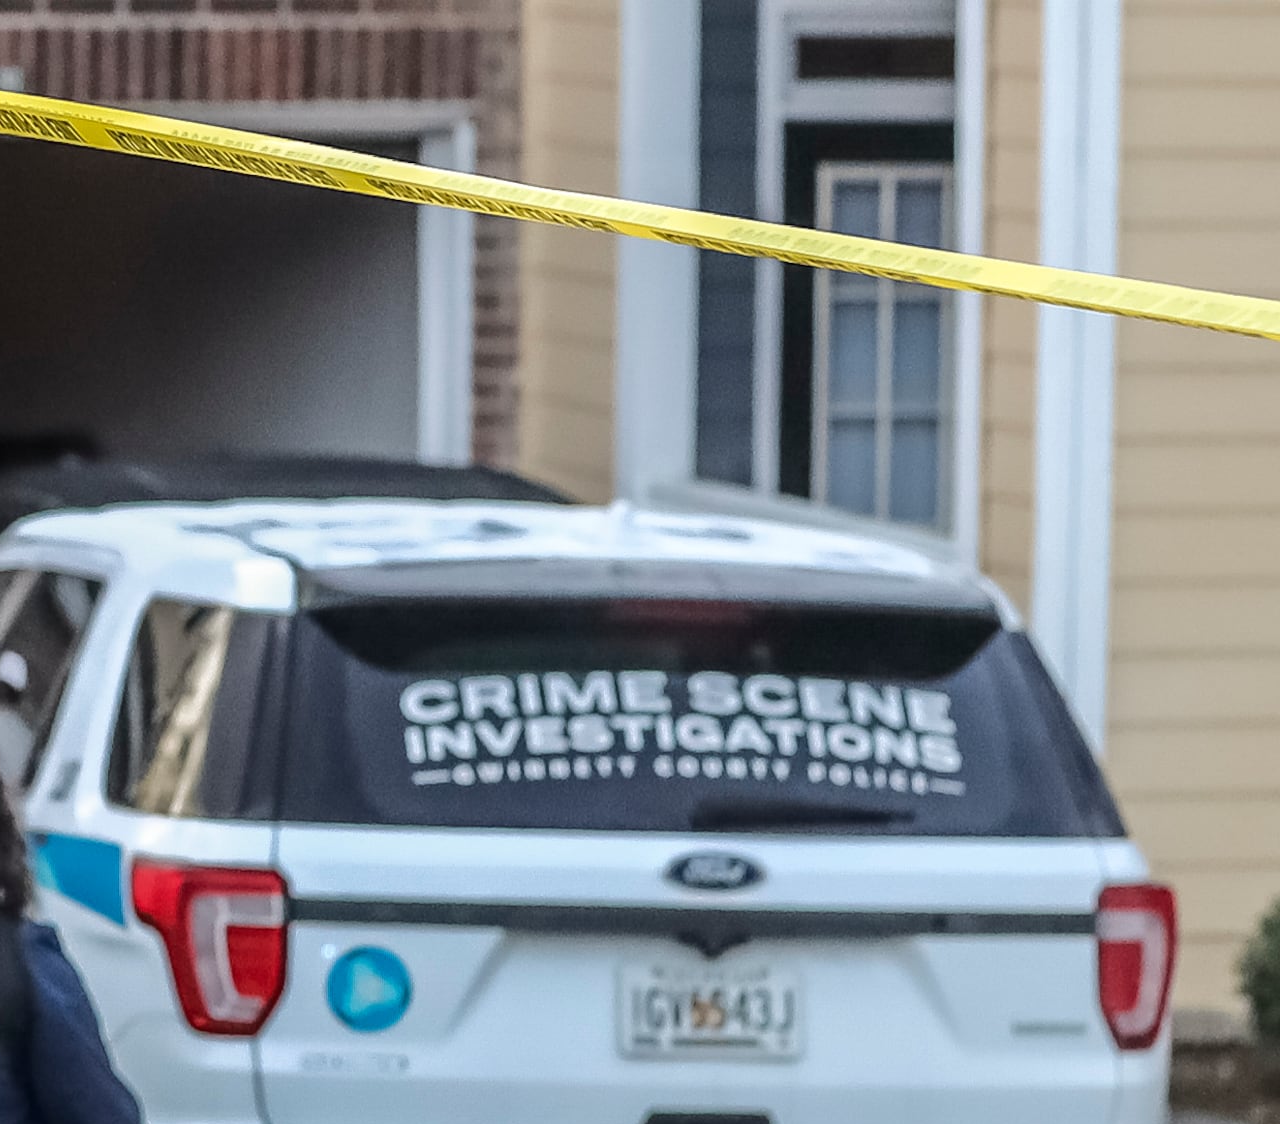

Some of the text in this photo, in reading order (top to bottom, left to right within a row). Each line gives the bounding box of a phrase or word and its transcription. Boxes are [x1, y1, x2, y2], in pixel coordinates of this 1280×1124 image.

[398, 670, 958, 736] CRIME SCENE
[403, 712, 964, 774] INVESTIGATIONS
